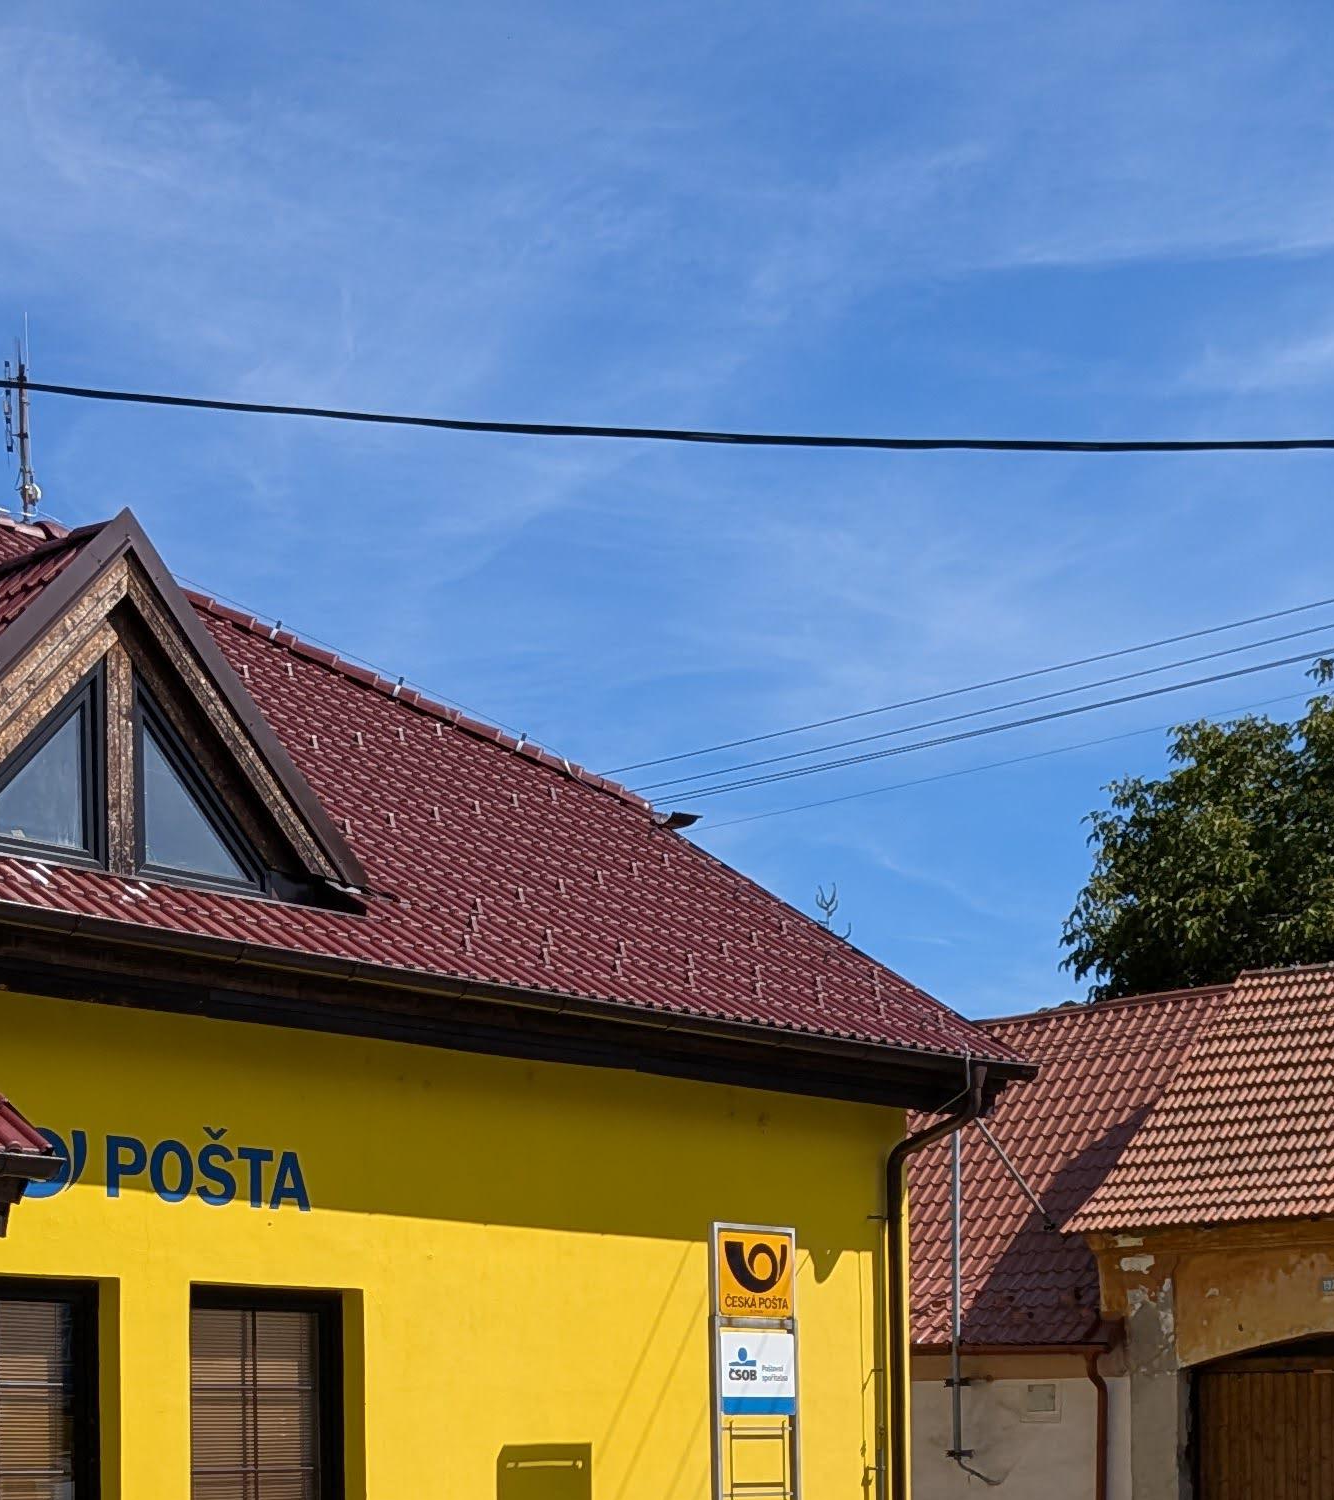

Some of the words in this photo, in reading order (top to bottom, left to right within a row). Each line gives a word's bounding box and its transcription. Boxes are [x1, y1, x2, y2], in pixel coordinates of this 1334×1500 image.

[105, 1126, 312, 1212] POŠTA
[725, 1293, 757, 1308] ČESKÁ
[758, 1296, 788, 1310] POŠTA
[729, 1368, 757, 1380] ČSOB
